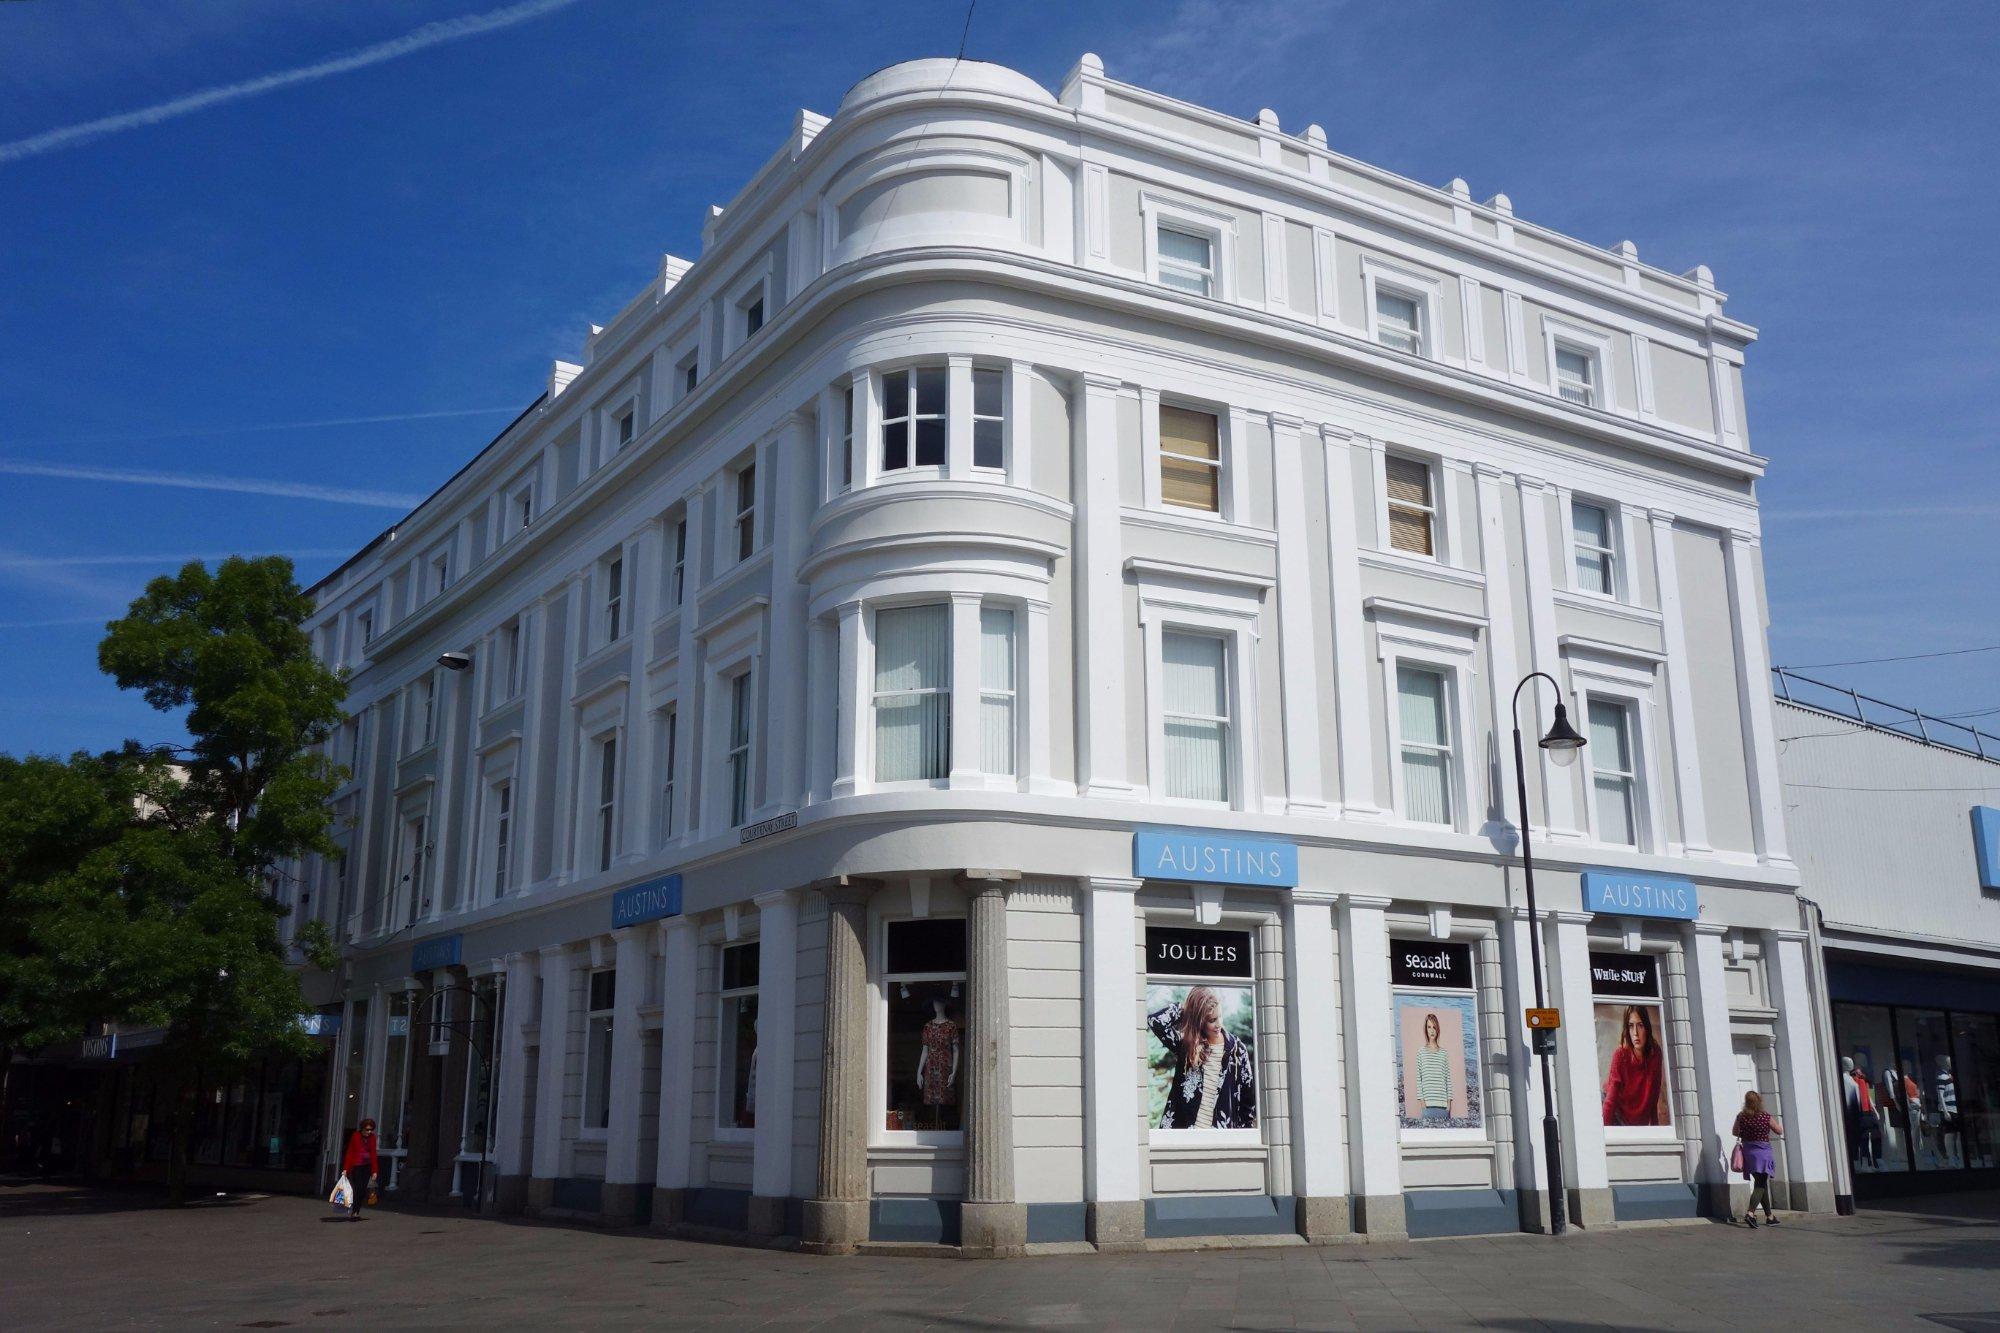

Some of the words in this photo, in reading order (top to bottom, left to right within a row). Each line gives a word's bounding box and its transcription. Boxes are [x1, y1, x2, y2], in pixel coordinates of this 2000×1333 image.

[775, 815, 795, 831] STREET
[1158, 845, 1281, 878] AUSTINS
[618, 885, 667, 919] AUSTINS
[1602, 884, 1687, 912] AUSTINS
[1158, 943, 1236, 962] JOULES
[1405, 951, 1451, 970] seasalt
[1412, 971, 1446, 979] CORNWALL
